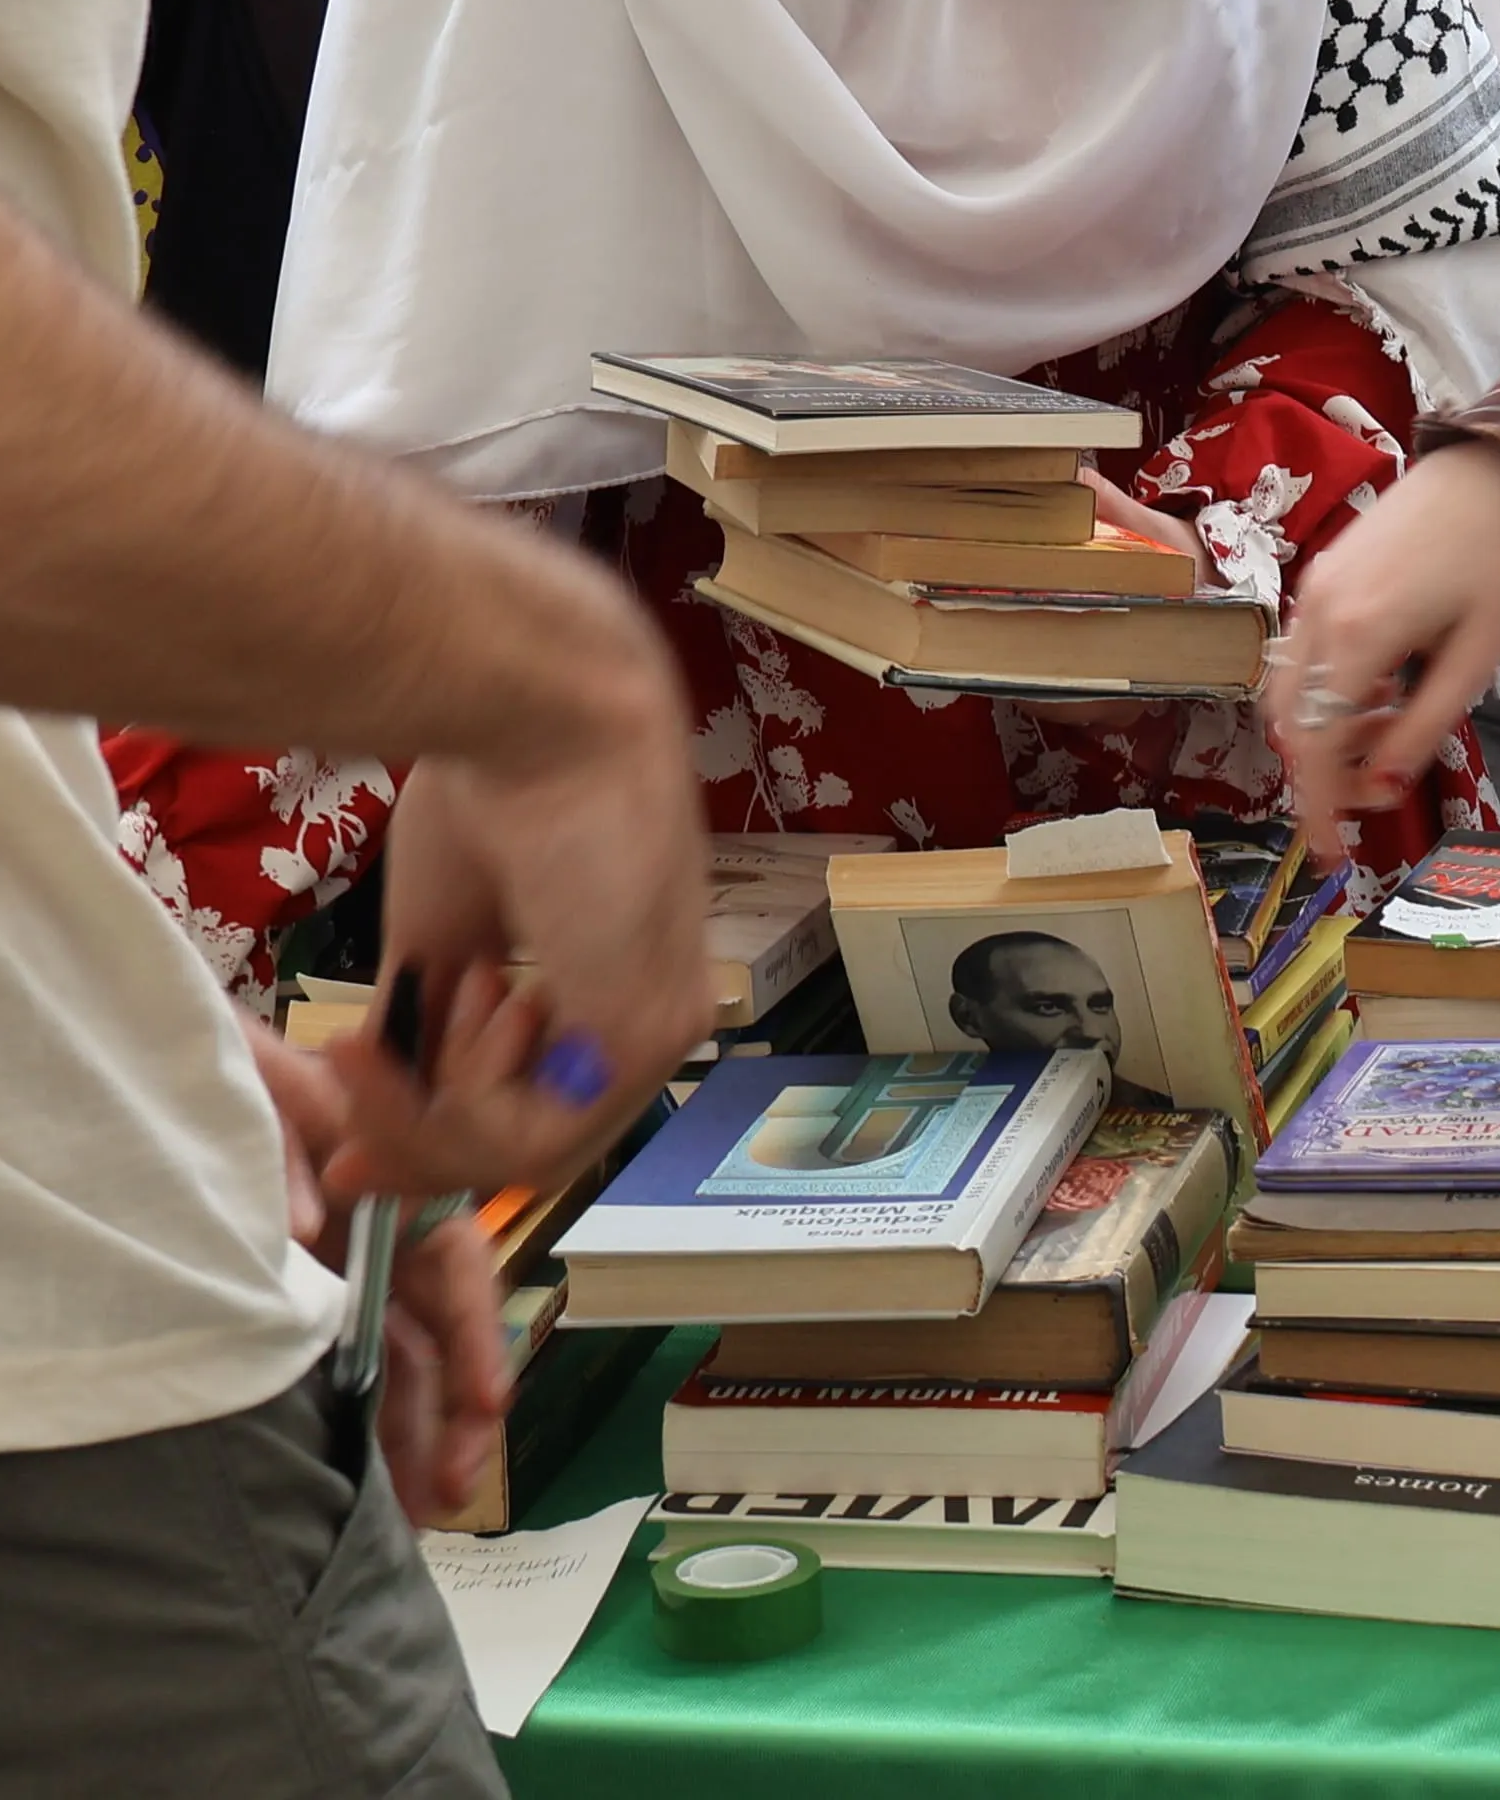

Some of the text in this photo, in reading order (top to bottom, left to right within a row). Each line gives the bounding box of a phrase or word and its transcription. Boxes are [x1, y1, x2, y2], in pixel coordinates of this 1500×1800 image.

[733, 1203, 955, 1219] de Marràqueix
[781, 1214, 948, 1228] Seduccions
[806, 1226, 937, 1238] Josep Piera
[1354, 1473, 1492, 1500] homes
